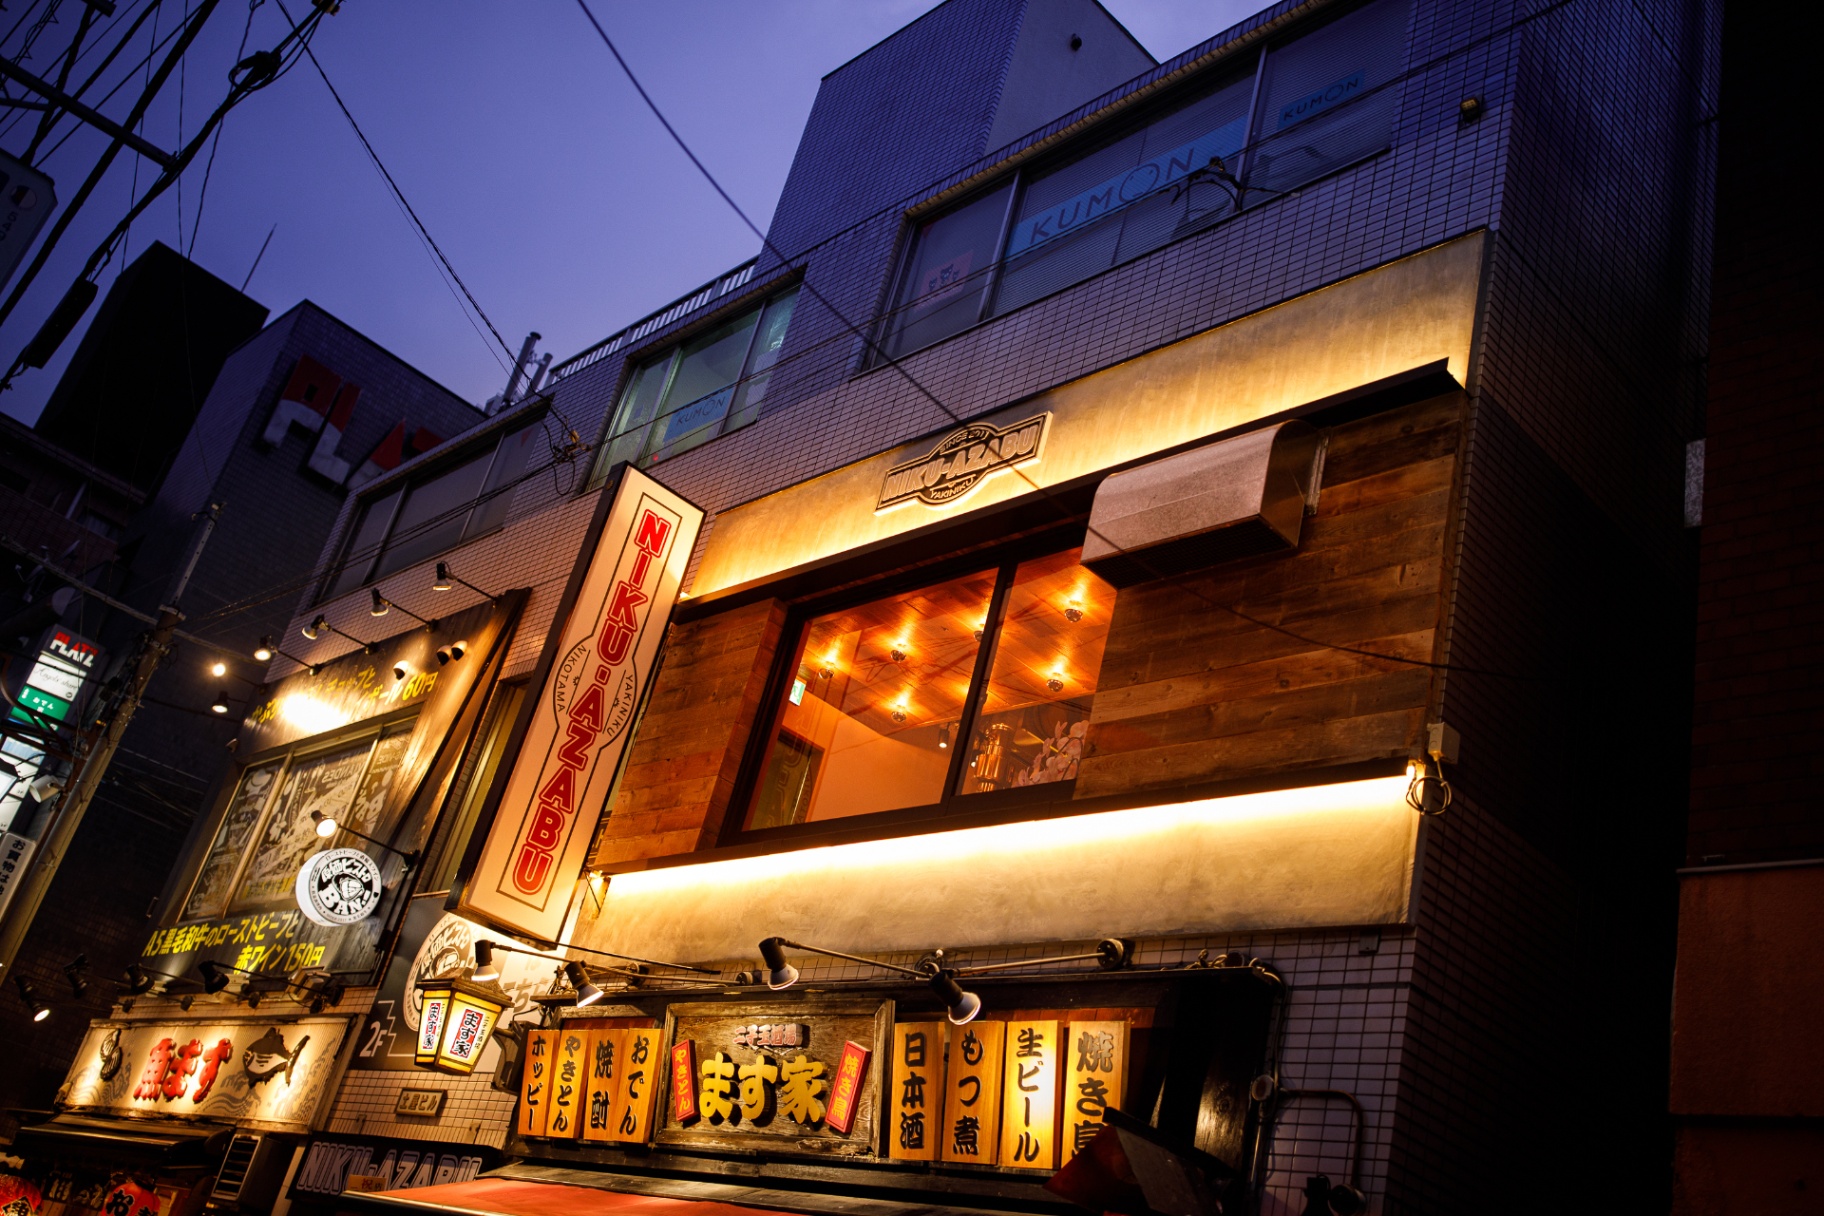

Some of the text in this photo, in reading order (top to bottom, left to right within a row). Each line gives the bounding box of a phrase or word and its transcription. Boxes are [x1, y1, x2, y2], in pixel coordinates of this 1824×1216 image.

[1283, 77, 1360, 121] KUMON
[1030, 148, 1195, 245] KUMON
[676, 395, 726, 425] KUMON
[883, 424, 1039, 501] NIKU-AZABU
[930, 474, 976, 499] YAKINIKU
[50, 631, 99, 668] PLATZ
[556, 644, 587, 713] NIKOTAMA
[607, 674, 634, 737] YAKINIKU
[318, 884, 371, 916] BAN!
[359, 1021, 388, 1058] 2F
[424, 1005, 438, 1047] ます家
[454, 1012, 478, 1056] ます家
[527, 1035, 547, 1131] ホッピー
[552, 1035, 581, 1132] やきとん
[590, 1038, 615, 1131] 焼酎
[619, 1035, 651, 1136] おでん
[674, 1048, 691, 1112] やきとん
[700, 1051, 826, 1125] ます家
[831, 1053, 860, 1121] 焼き鳥
[900, 1032, 927, 1150] 日本酒
[953, 1029, 984, 1156] もつ煮
[1014, 1027, 1045, 1162] 生ビール
